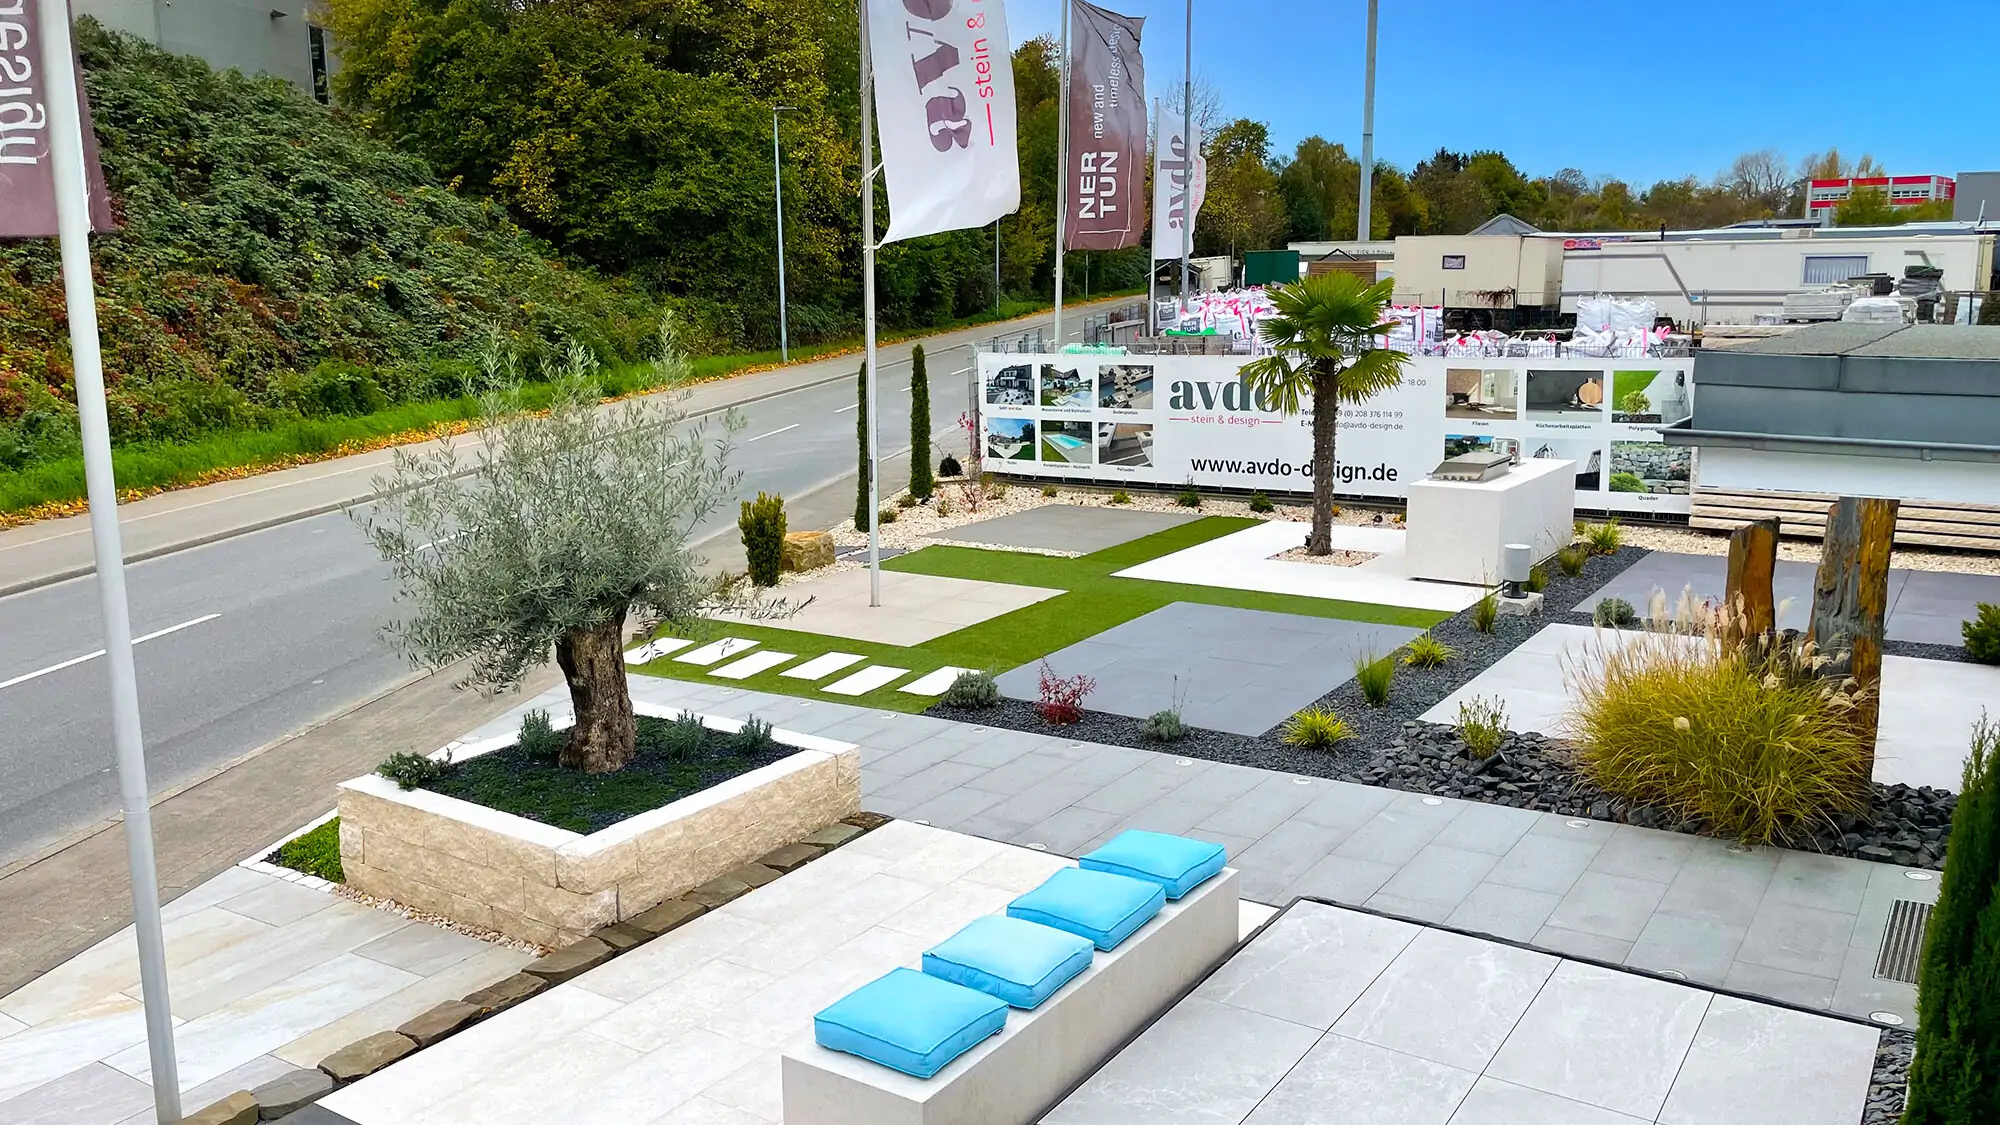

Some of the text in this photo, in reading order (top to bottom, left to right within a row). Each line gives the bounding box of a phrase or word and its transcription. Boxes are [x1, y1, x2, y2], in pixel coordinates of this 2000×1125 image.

[966, 10, 994, 98] stein &
[1108, 56, 1121, 108] timeless
[1093, 84, 1105, 139] new and
[1078, 151, 1097, 219] NER
[1098, 151, 1119, 219] TUN
[1190, 414, 1260, 427] stein & design
[1354, 410, 1368, 418] 208
[1394, 411, 1403, 419] 99
[1190, 458, 1399, 484] www.avdo-dign.de
